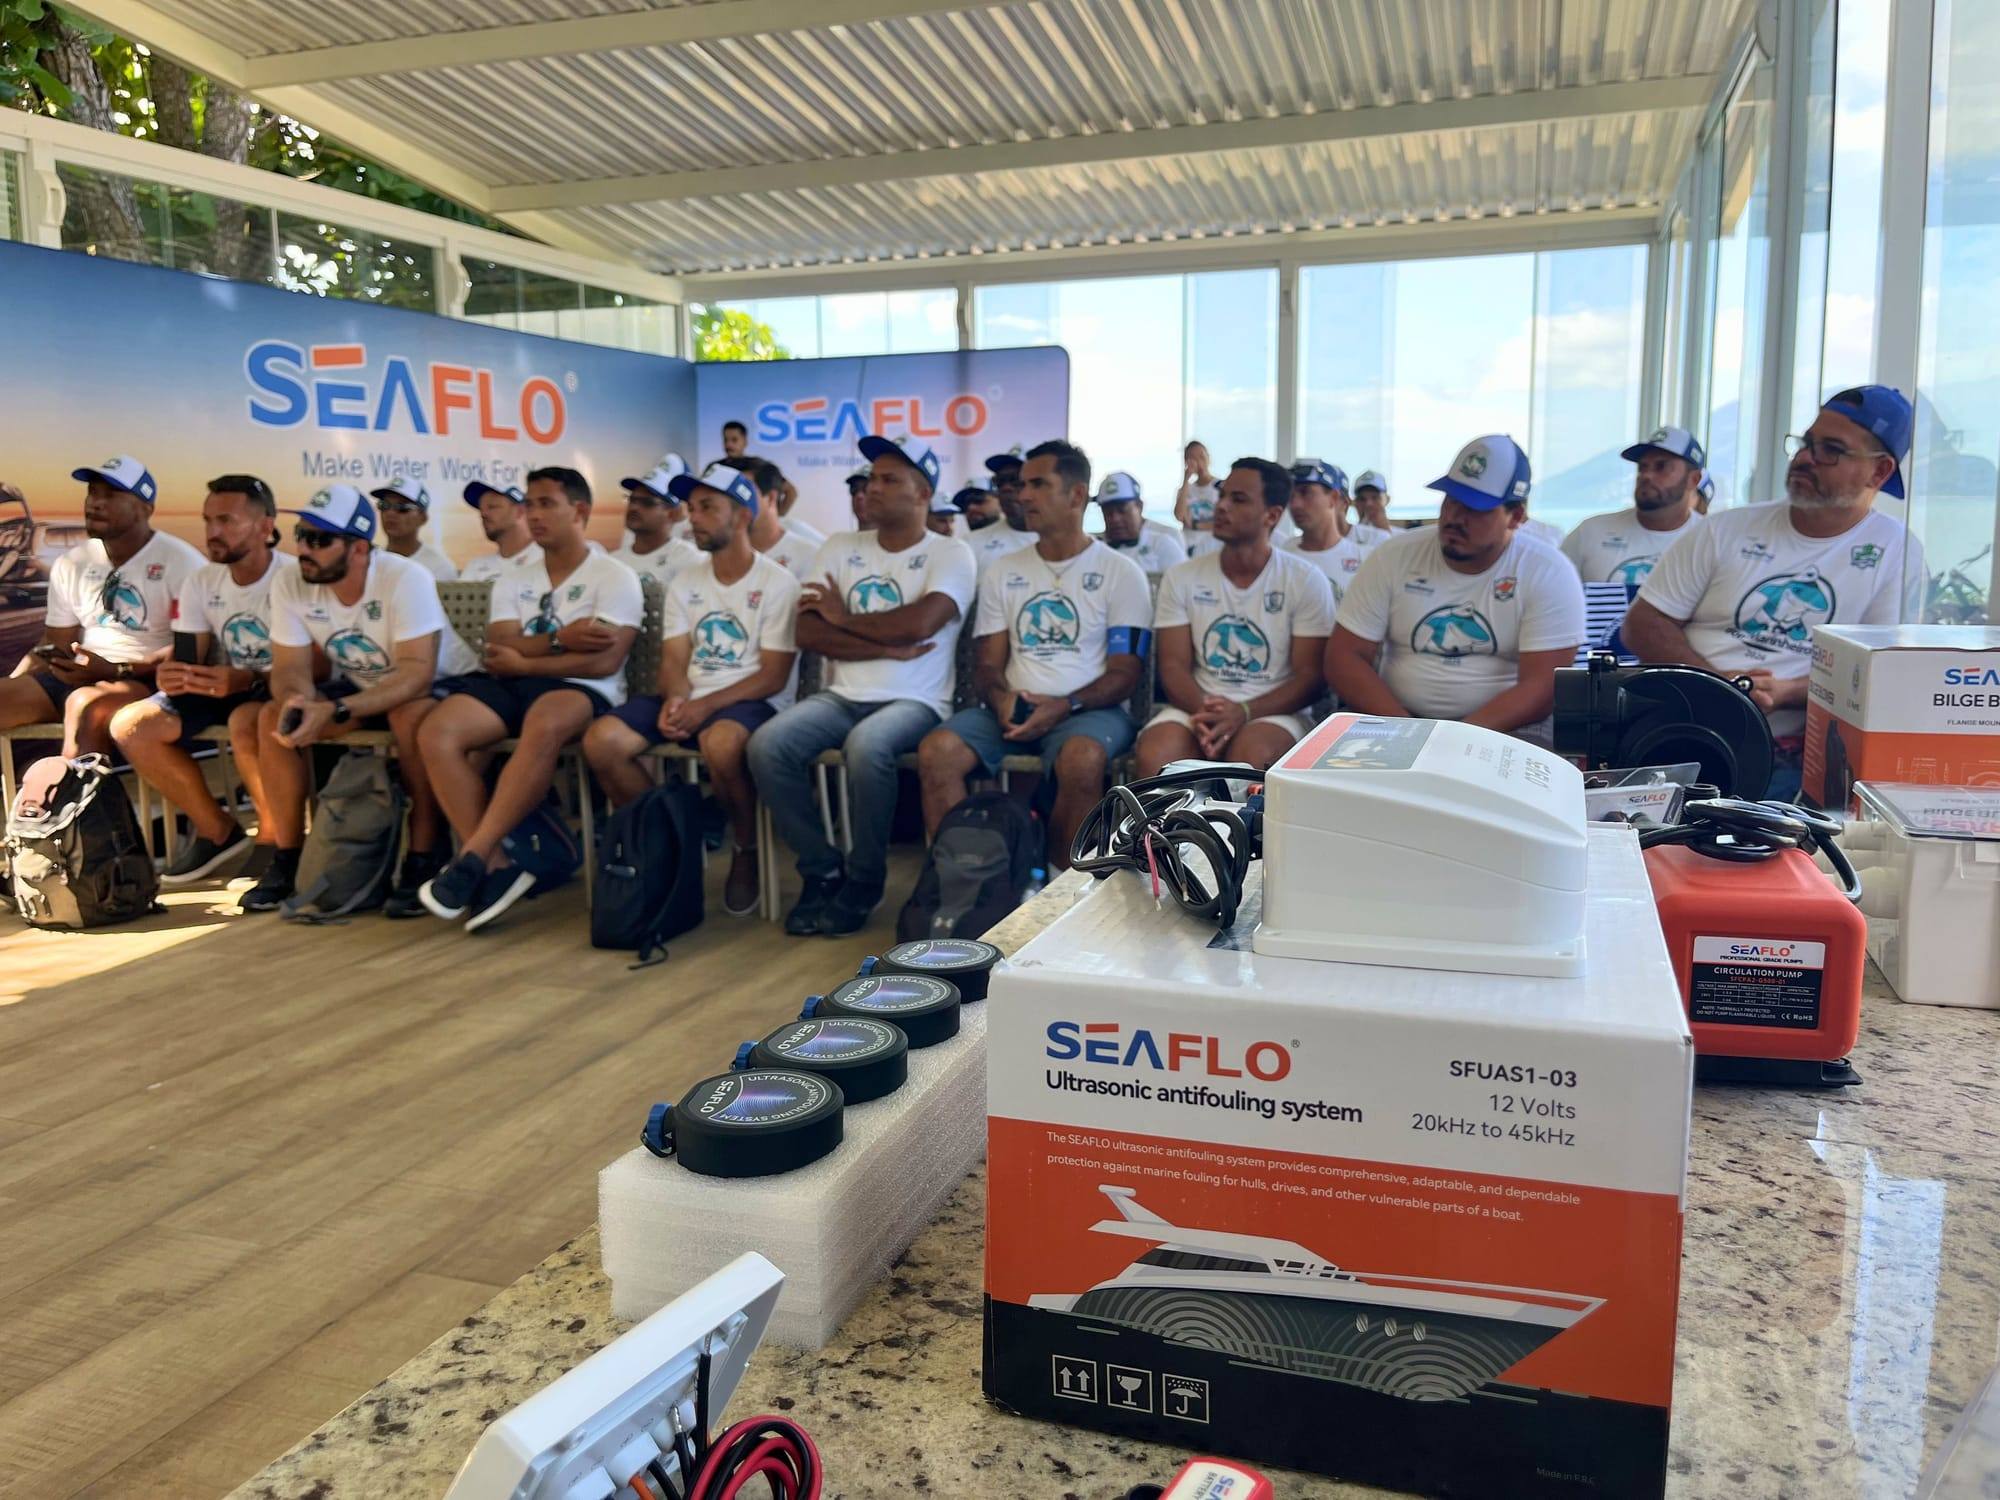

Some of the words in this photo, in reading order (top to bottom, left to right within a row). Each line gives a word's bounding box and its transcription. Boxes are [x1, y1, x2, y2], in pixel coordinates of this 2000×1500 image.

[302, 451, 363, 477] Make
[369, 452, 431, 479] Water
[439, 456, 488, 480] Work
[491, 460, 520, 482] For
[1933, 693, 1984, 708] BILGE
[1730, 944, 1790, 957] SEAFLO
[1713, 967, 1775, 978] CIRCULATION
[1776, 970, 1803, 979] PUMP
[778, 1023, 816, 1050] SEAFLO
[791, 1050, 834, 1059] SYSTEM
[748, 1074, 815, 1091] ULTRASONIC
[1449, 1060, 1577, 1088] SFUAS1-03
[700, 1080, 735, 1113] SEAFLO
[1046, 1070, 1152, 1100] Ultrasonic
[1157, 1084, 1276, 1118] antifouling
[1281, 1099, 1363, 1123] system
[1489, 1094, 1514, 1113] 12
[1520, 1096, 1576, 1119] Volts
[719, 1114, 769, 1122] SYSTEM
[1411, 1113, 1476, 1136] 20kHz
[1481, 1122, 1502, 1138] to
[1508, 1123, 1576, 1146] 45kHz
[1047, 1131, 1066, 1143] The
[1067, 1133, 1111, 1149] SEAFLO
[1112, 1140, 1164, 1155] ultrasonic
[1166, 1147, 1224, 1166] antifouling
[1226, 1155, 1266, 1168] system
[1268, 1159, 1317, 1174] provides
[1318, 1166, 1410, 1185] comprehensive,
[1412, 1176, 1476, 1194] adaptable,
[1479, 1184, 1502, 1196] and
[1505, 1186, 1580, 1205] dependable
[1047, 1154, 1101, 1169] protection
[1102, 1161, 1142, 1175] against
[1143, 1166, 1181, 1179] marine
[1182, 1169, 1220, 1186] fouling
[1222, 1174, 1239, 1187] for
[1240, 1177, 1269, 1191] hulls,
[1271, 1181, 1308, 1196] drives,
[1311, 1186, 1333, 1198] and
[1335, 1189, 1367, 1201] other
[1368, 1193, 1430, 1209] vulnerable
[1433, 1201, 1465, 1215] parts
[1466, 1204, 1481, 1216] of
[1482, 1208, 1490, 1217] a
[1492, 1207, 1524, 1221] boat.
